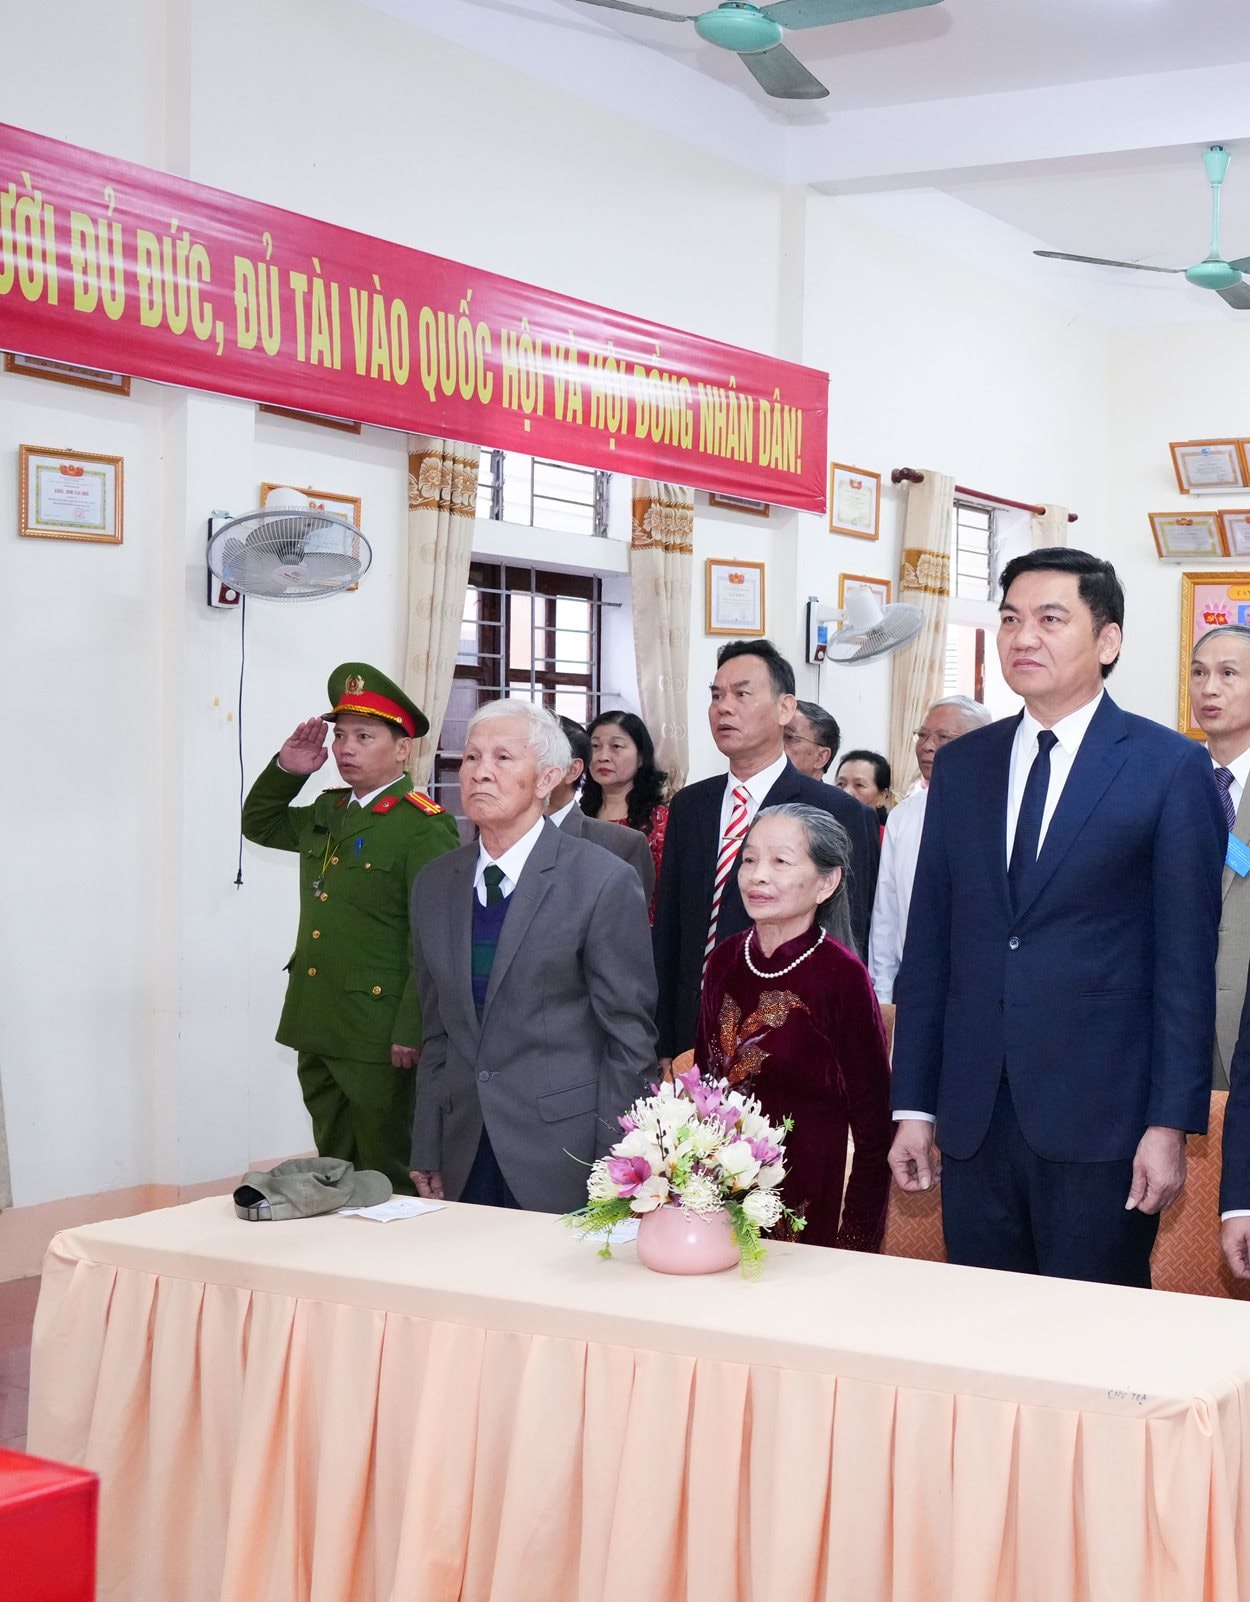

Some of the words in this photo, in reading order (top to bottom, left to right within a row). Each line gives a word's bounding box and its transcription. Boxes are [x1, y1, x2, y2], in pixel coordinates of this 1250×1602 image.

[70, 185, 126, 321] ĐỦ
[136, 217, 224, 357] ĐỨC,
[234, 231, 281, 357] ĐỦ
[289, 256, 342, 371] TÀI
[349, 273, 410, 386] VÀO
[418, 288, 494, 405] QUỐC
[501, 316, 544, 432] HỘI
[549, 329, 583, 425] VÀ
[588, 340, 628, 450] HỘI
[633, 343, 694, 450] ĐỒNG
[697, 375, 754, 464] NHÂN
[758, 387, 803, 475] DÂN!
